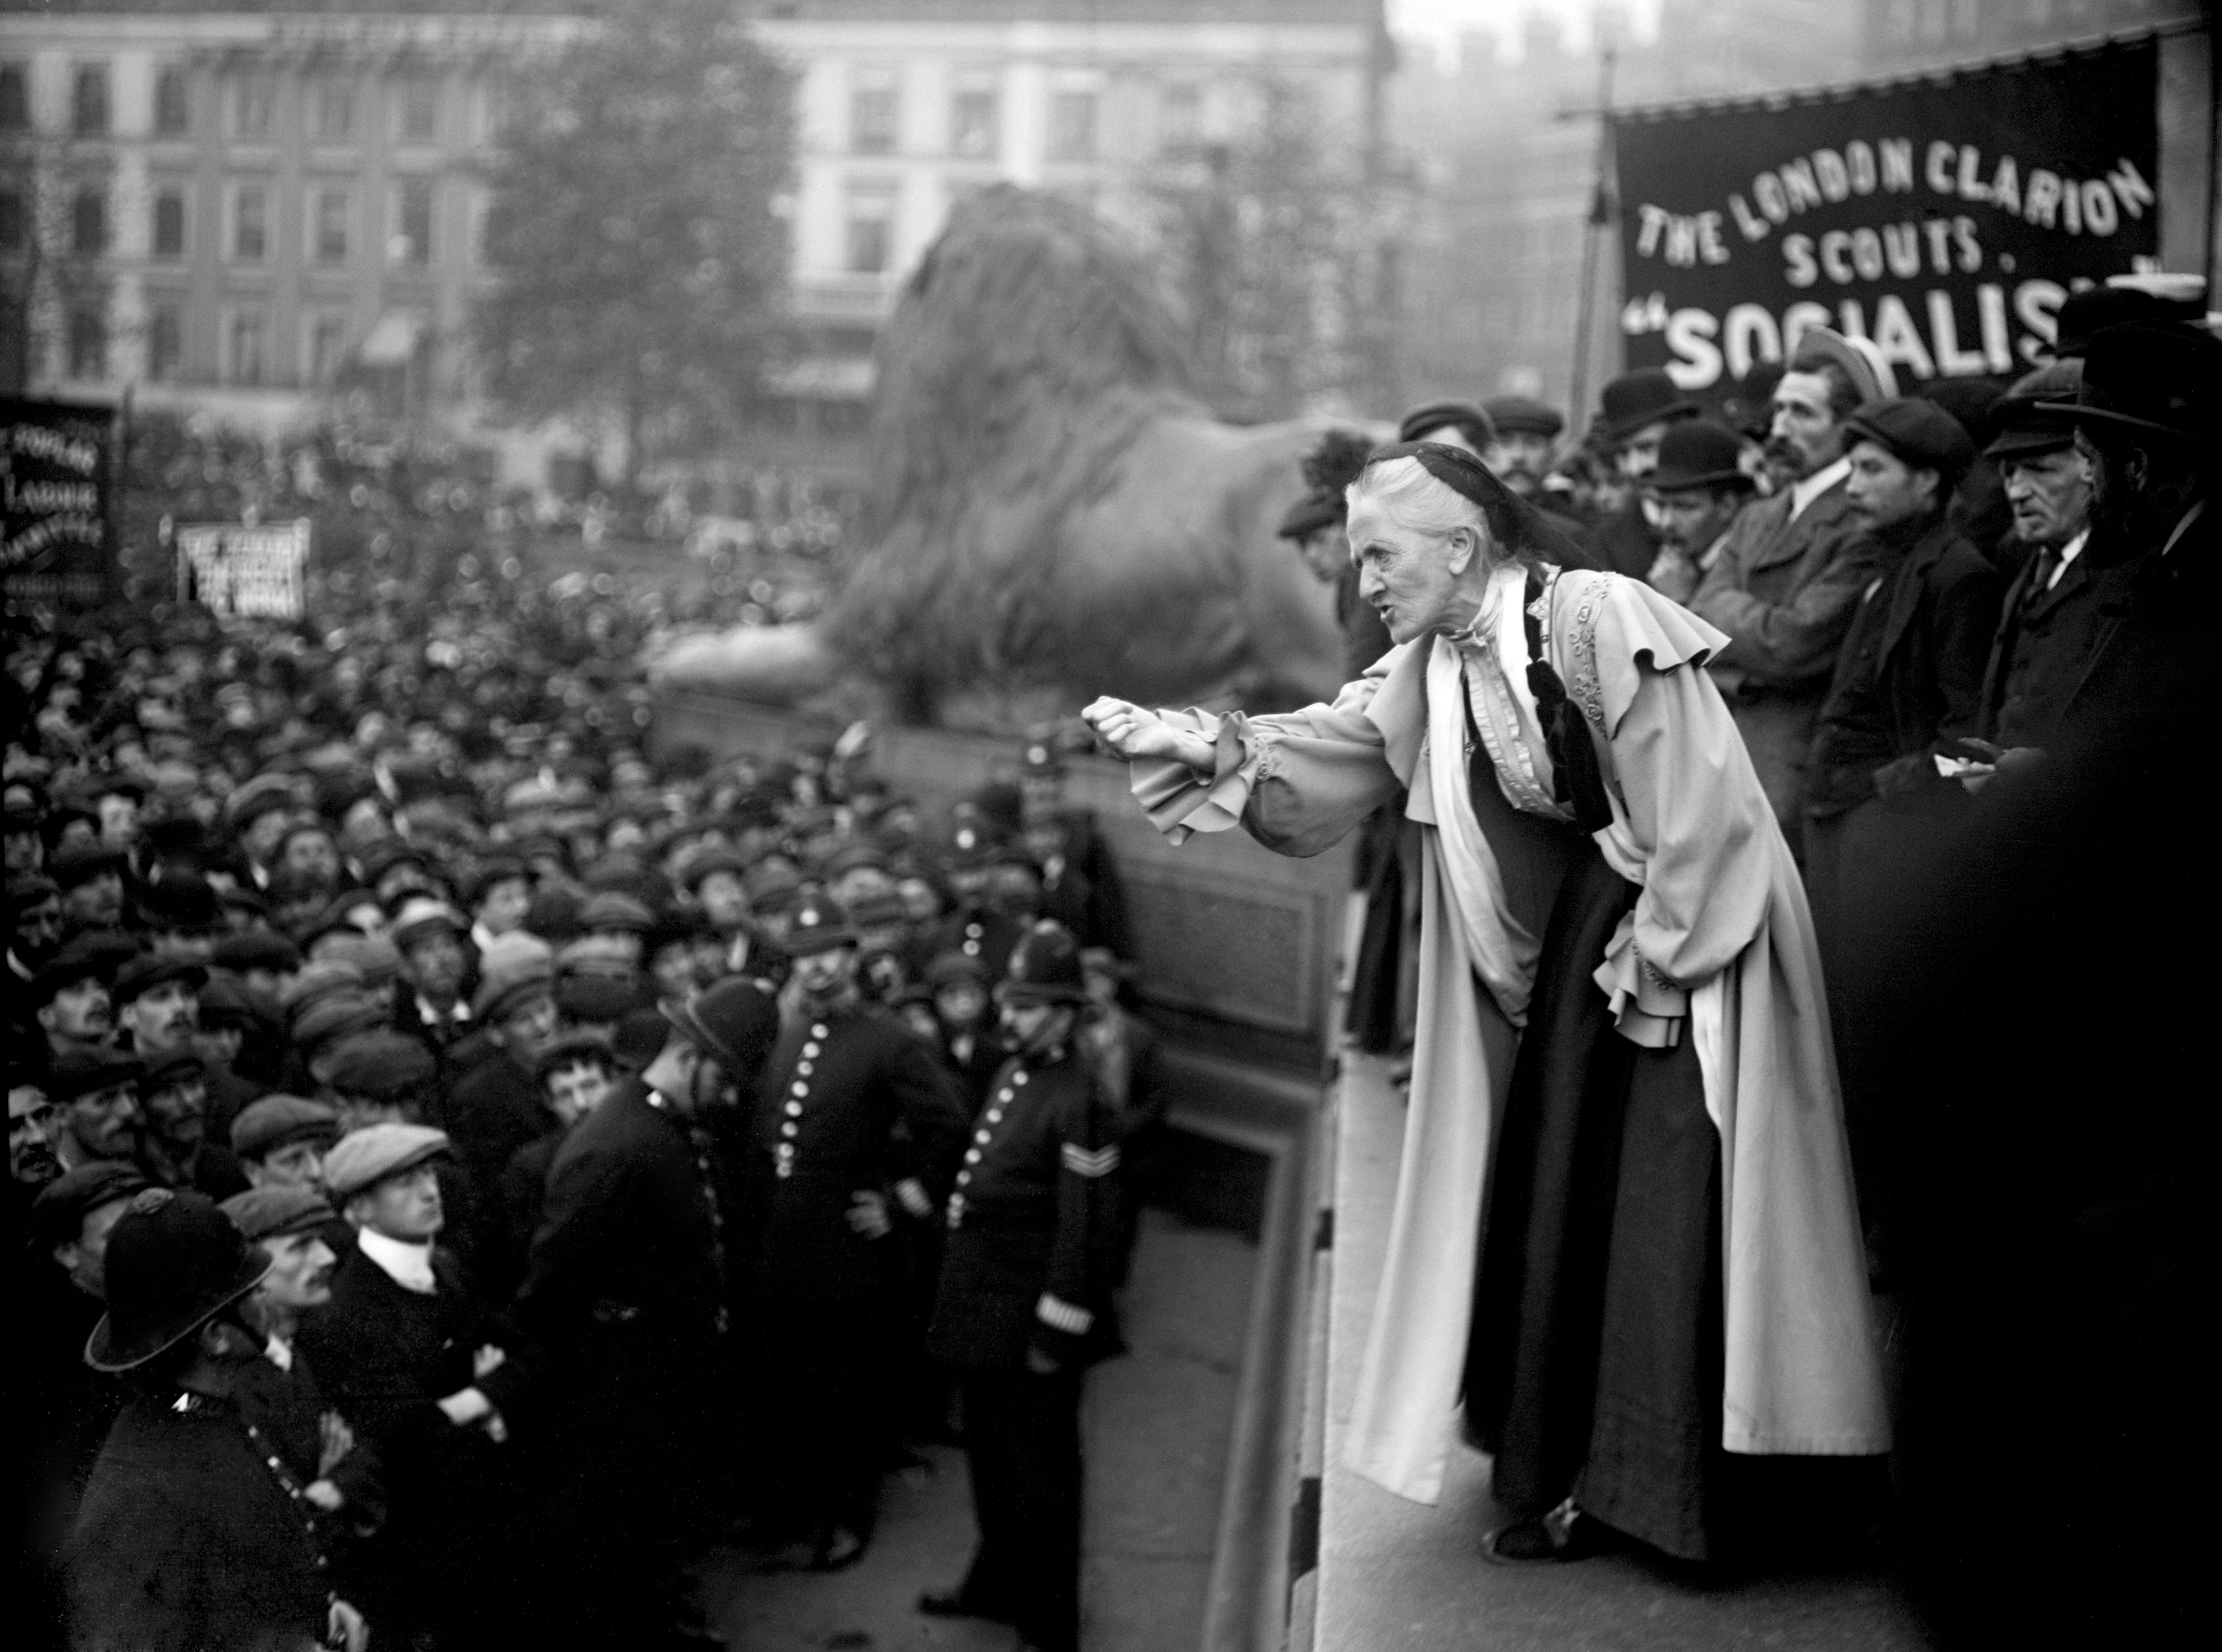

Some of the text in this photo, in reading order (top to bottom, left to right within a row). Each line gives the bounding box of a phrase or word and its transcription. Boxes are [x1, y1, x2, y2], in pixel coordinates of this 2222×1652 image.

[1636, 137, 2157, 268] THE LONDON CLARION
